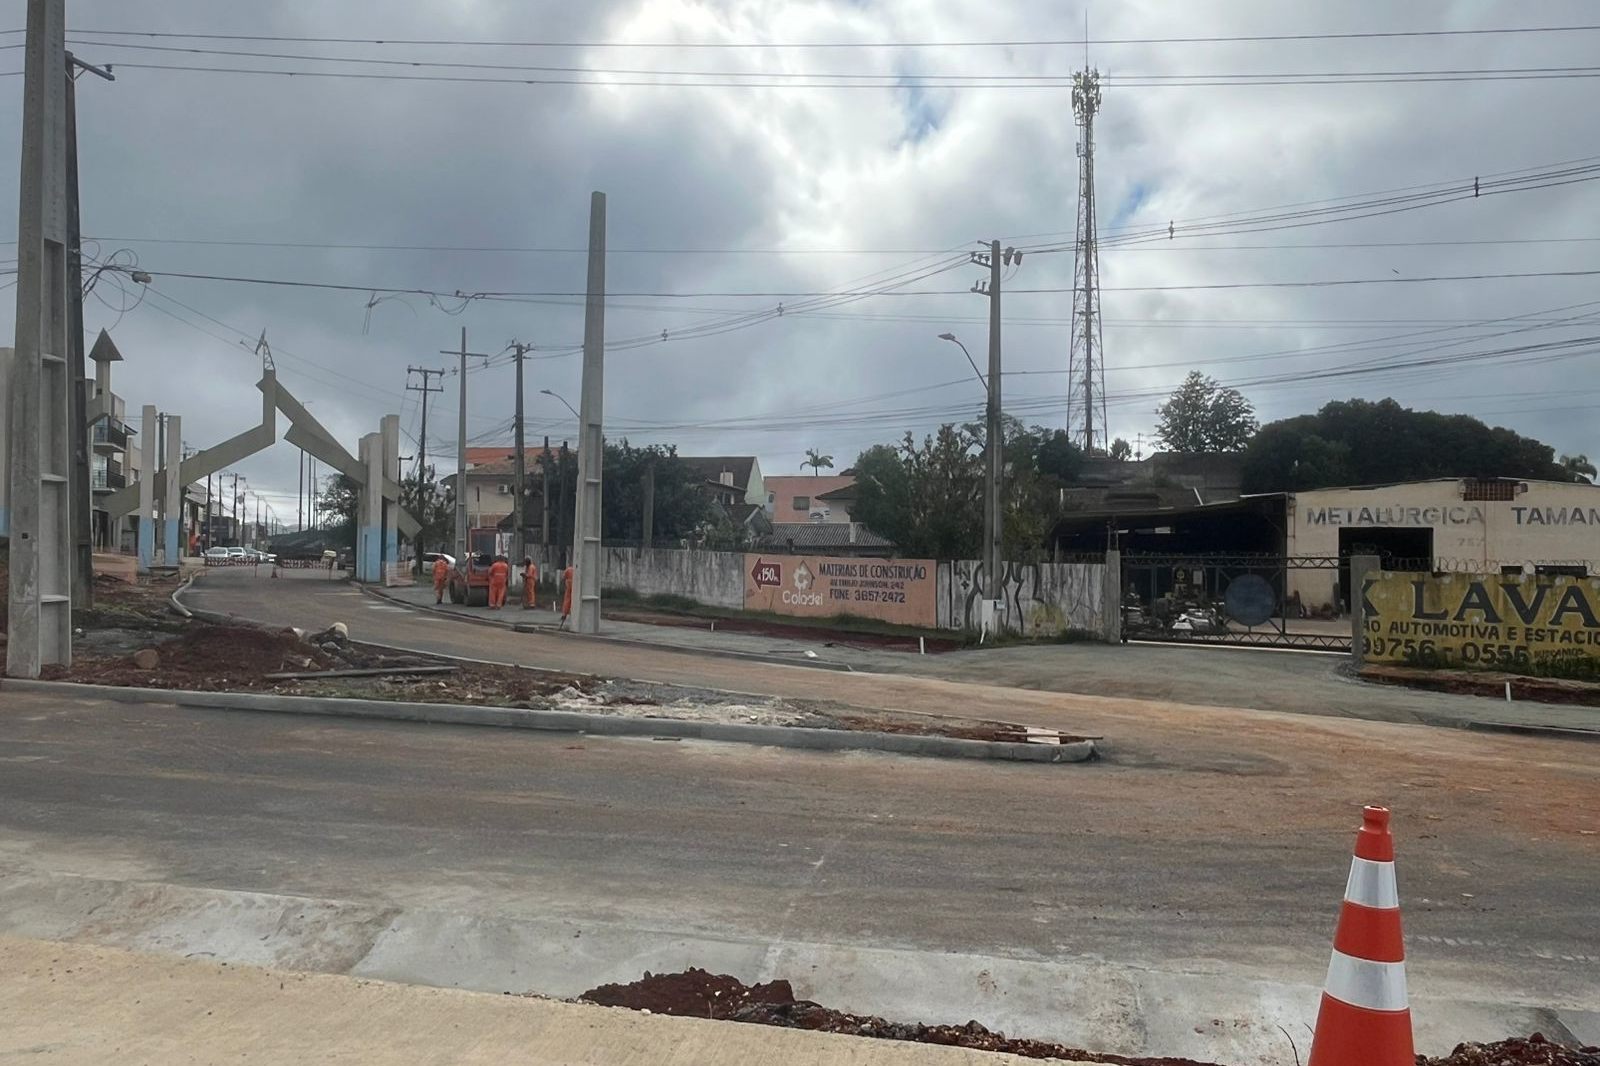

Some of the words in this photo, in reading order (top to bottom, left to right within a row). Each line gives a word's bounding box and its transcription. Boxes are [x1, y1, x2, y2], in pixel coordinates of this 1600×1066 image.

[818, 563, 857, 577] MATERIAIS
[859, 565, 868, 578] DE
[870, 564, 927, 581] CONSTRUÇÃO
[1389, 621, 1500, 641] AUTOMOTIVA
[1507, 626, 1517, 641] E
